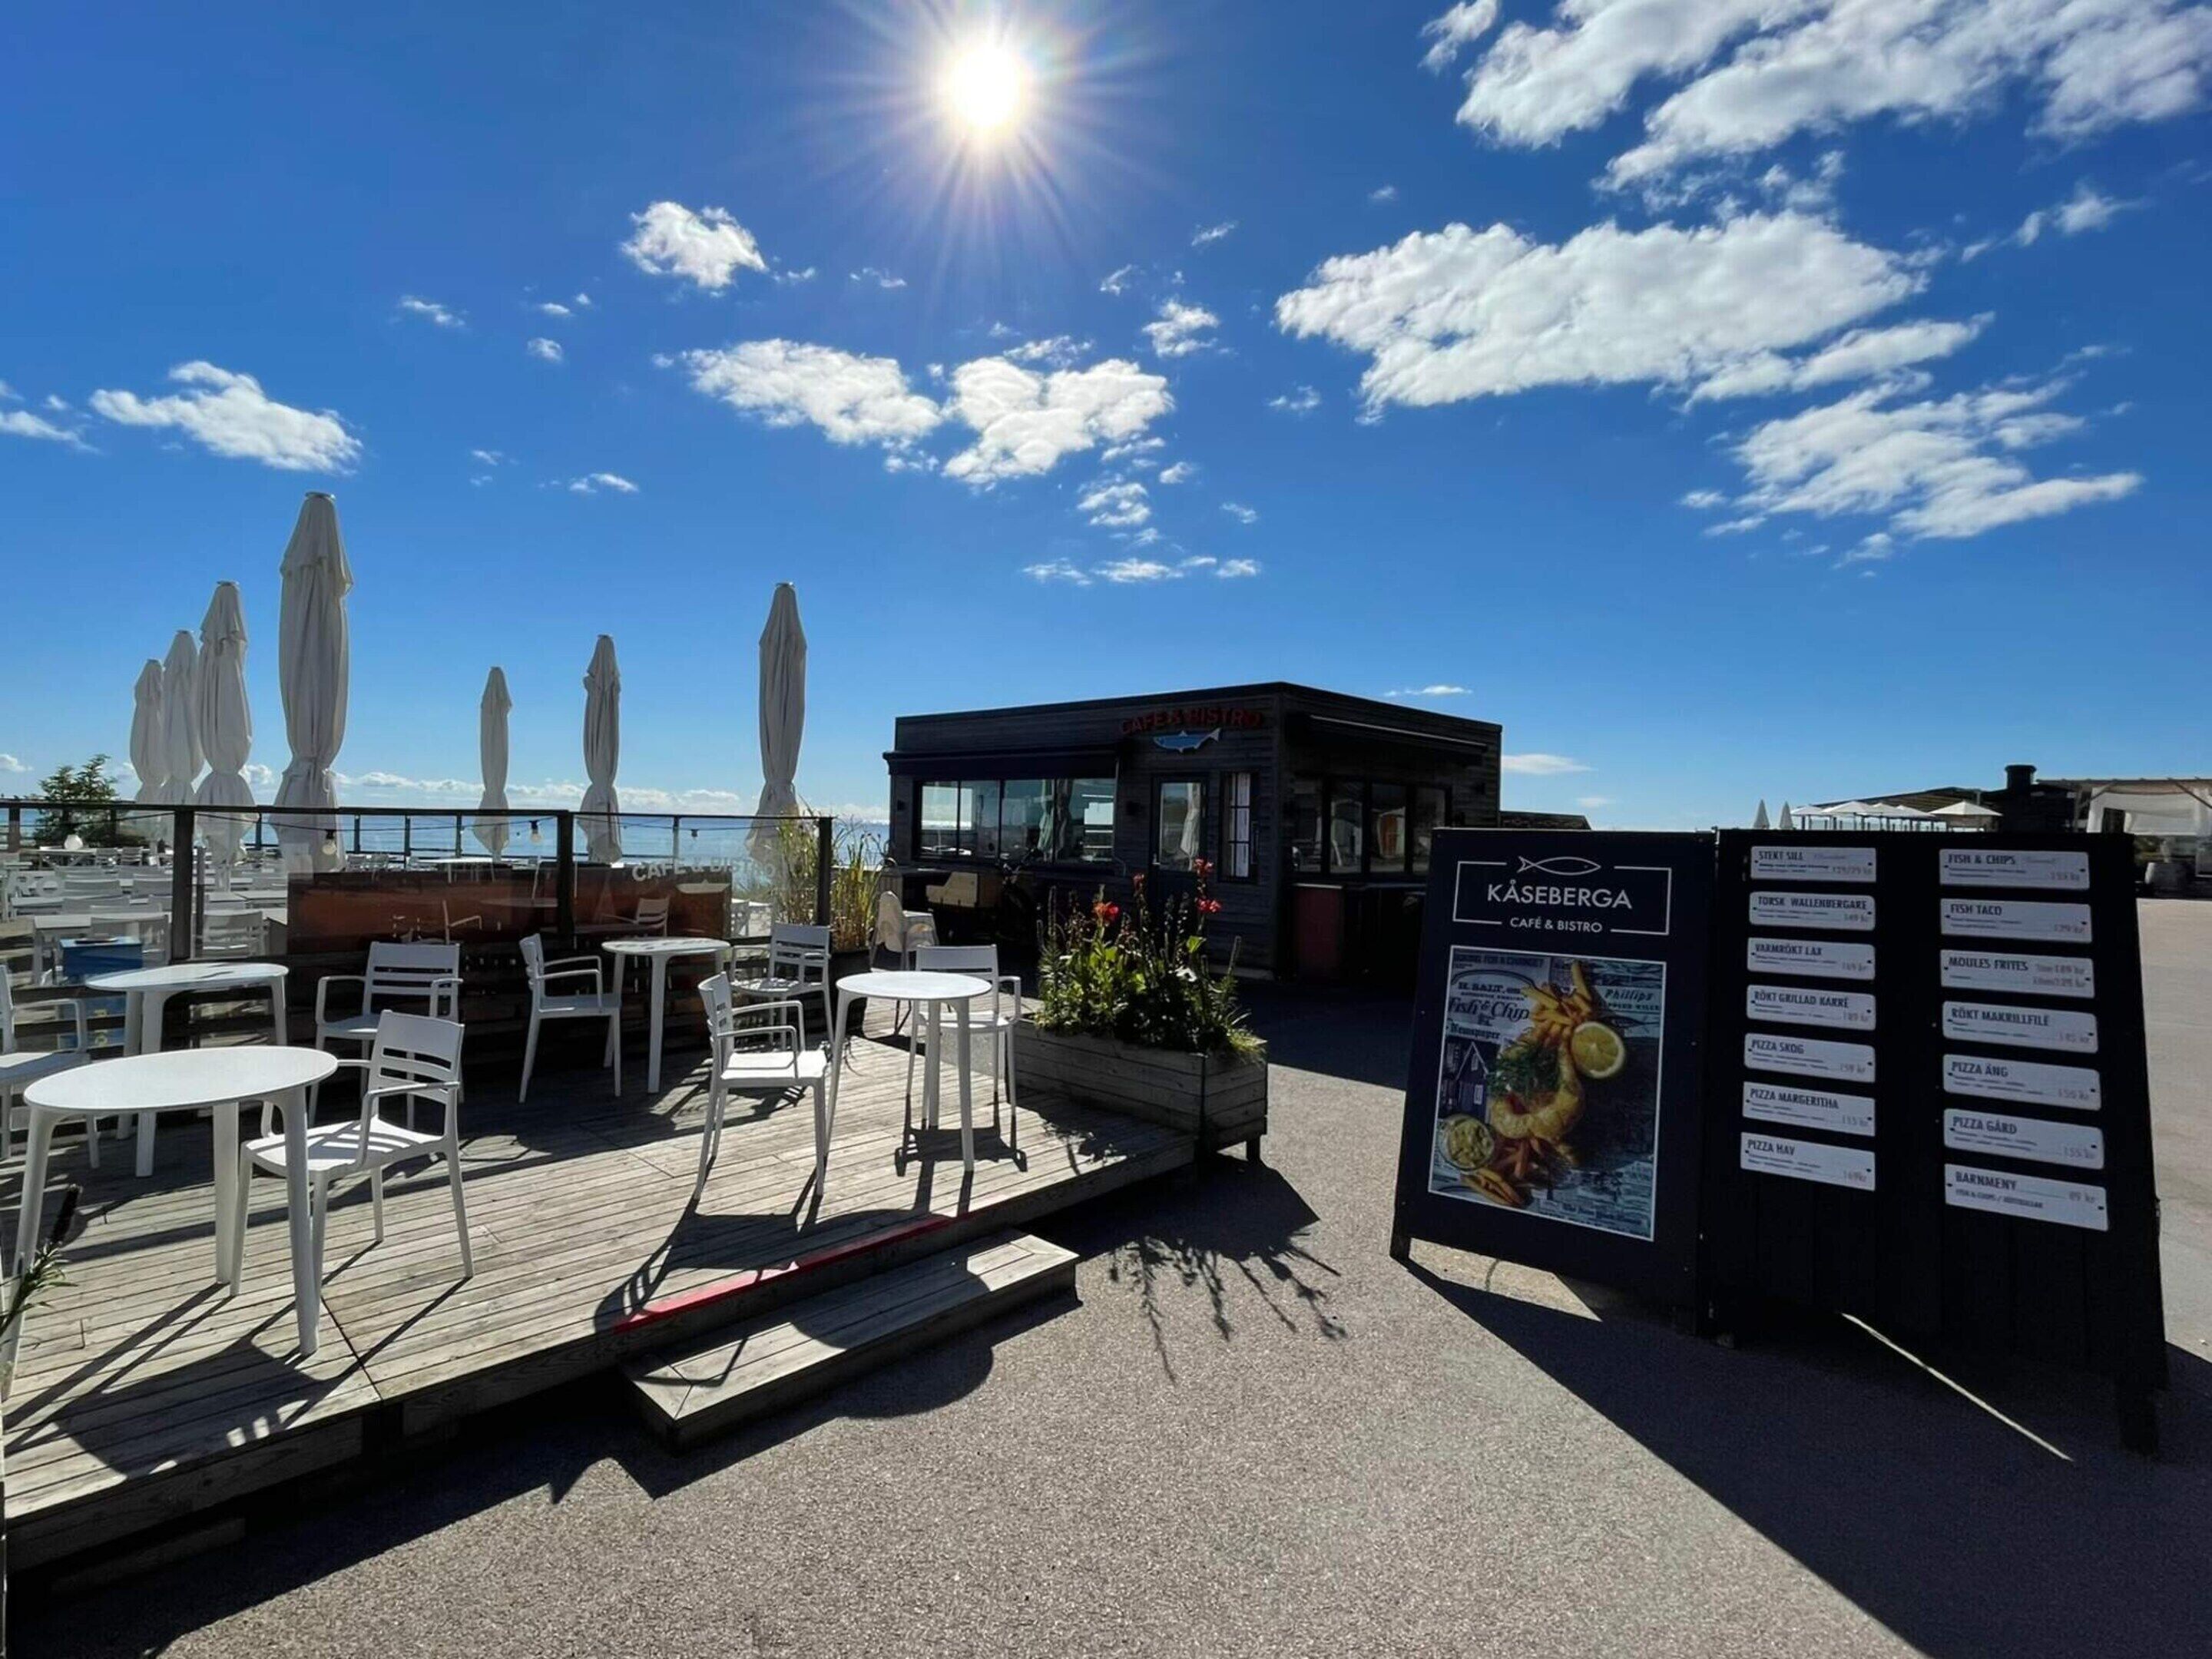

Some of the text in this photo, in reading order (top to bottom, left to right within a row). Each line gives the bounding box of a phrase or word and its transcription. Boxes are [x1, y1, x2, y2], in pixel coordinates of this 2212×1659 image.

[1188, 707, 1263, 729] BISTRO
[1758, 850, 1783, 860] STEKT
[1786, 851, 1803, 861] SILL
[1949, 854, 1971, 864] FISH
[1974, 855, 1982, 864] &
[1986, 855, 2016, 865] CHIPS
[1488, 879, 1632, 909] KÅSEBERGA
[1758, 896, 1867, 910] TORSK WALLENBERGARE
[1950, 904, 2002, 916] FISH TACO
[1510, 917, 1602, 932] CAFÉ & BISTRO
[1755, 942, 1823, 956] VARMRÖKT LAX
[1949, 956, 1991, 969] MOULES
[1995, 959, 2028, 972] FRITES
[1604, 988, 1654, 1003] Phillips
[1754, 990, 1777, 1002] RÖKT
[1779, 993, 1816, 1005] GRILLAD
[1952, 1008, 1979, 1020] RÖKT
[1751, 1039, 1804, 1055] PIZZA SKOG
[1952, 1061, 2009, 1077] PIZZA ÄNG
[1750, 1088, 1839, 1109] PIZZA MARGERITHA
[1952, 1116, 2018, 1134] PIZZA GÅRD
[1747, 1139, 1796, 1156] PIZZA HAV
[1955, 1171, 2018, 1190] BARNMENY
